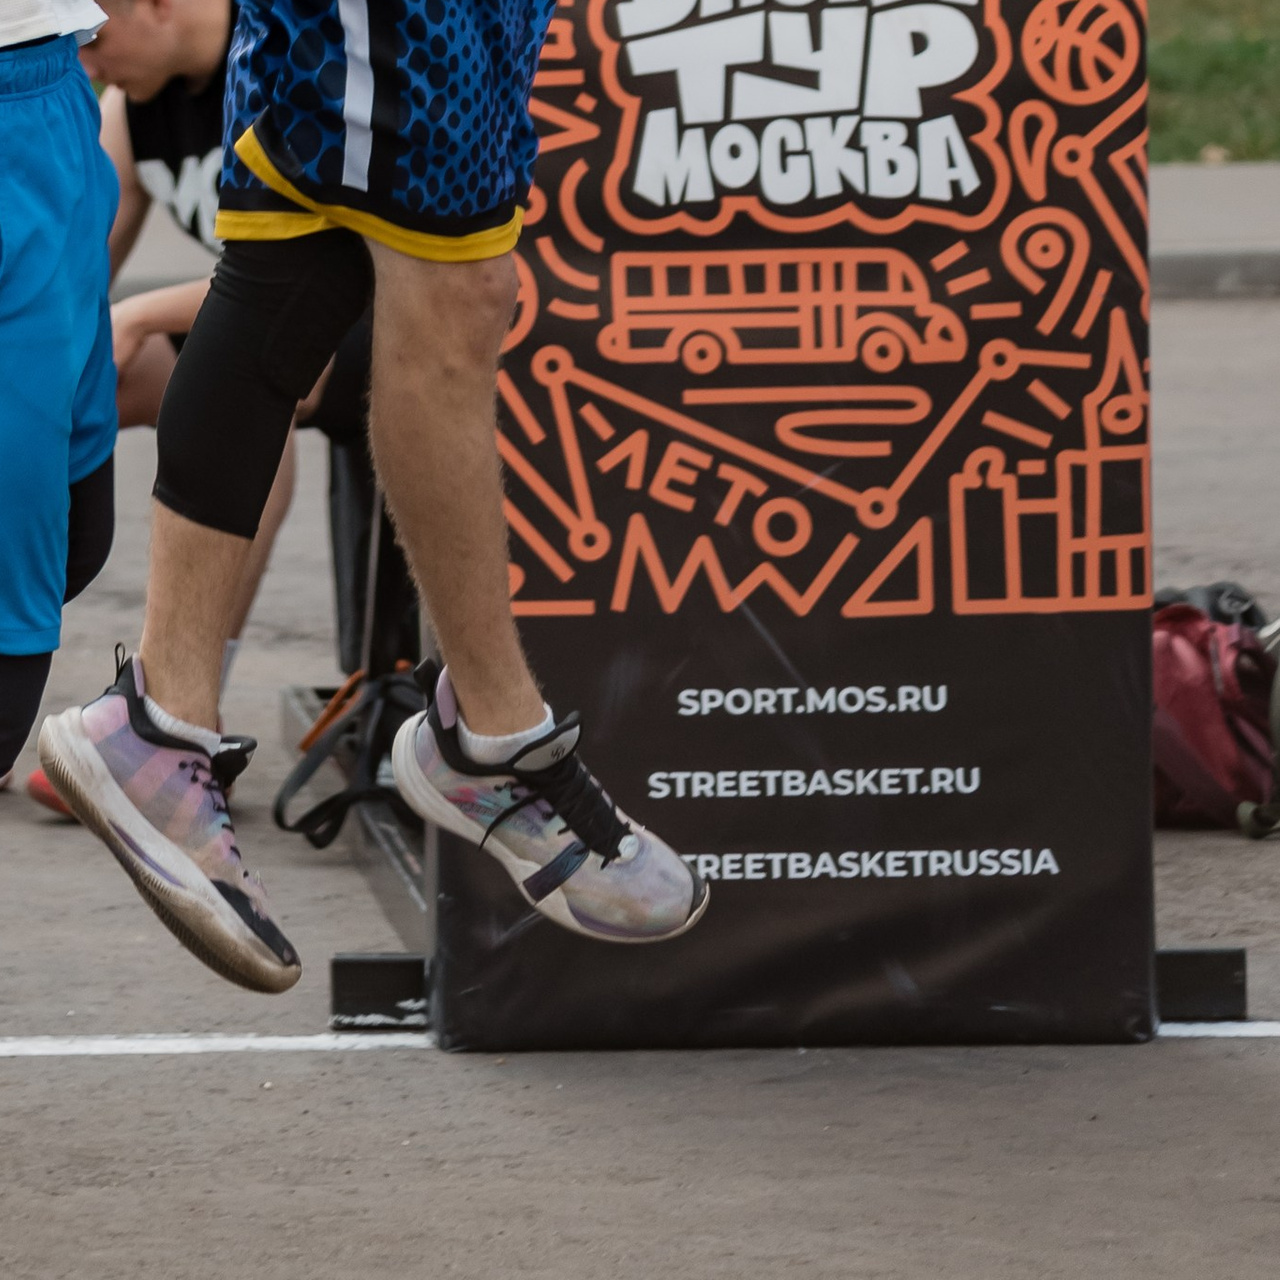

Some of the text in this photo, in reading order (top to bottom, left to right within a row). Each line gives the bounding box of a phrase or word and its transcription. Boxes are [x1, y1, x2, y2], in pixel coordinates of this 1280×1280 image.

[625, 2, 980, 125] ТУР
[632, 106, 982, 207] МОСКВА
[596, 428, 813, 557] ЛЕТО
[677, 685, 948, 716] SPORT.MOS.RU
[648, 766, 981, 799] STREETBASKET.RU
[680, 848, 1060, 880] REETBASKETRUSSIA
